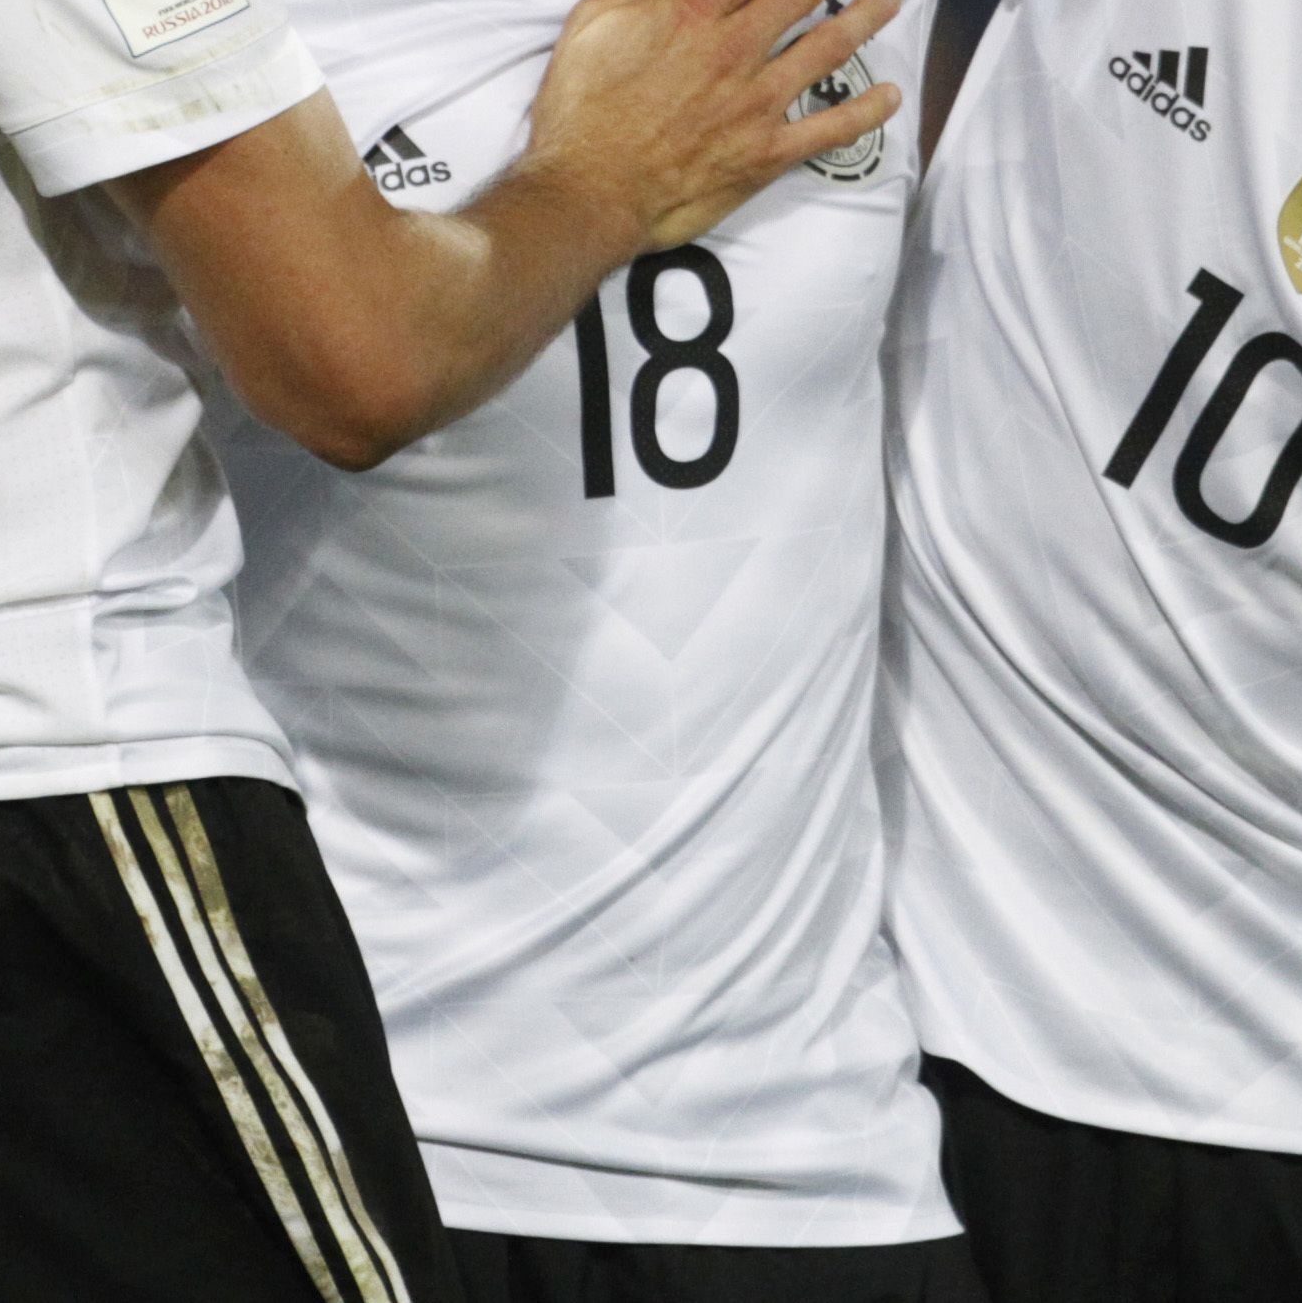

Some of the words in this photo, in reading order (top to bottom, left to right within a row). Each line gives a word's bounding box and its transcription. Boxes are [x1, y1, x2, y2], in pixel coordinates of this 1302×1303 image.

[142, 7, 202, 39] RUSSIA
[1108, 56, 1212, 142] adidas
[574, 244, 740, 499] 18
